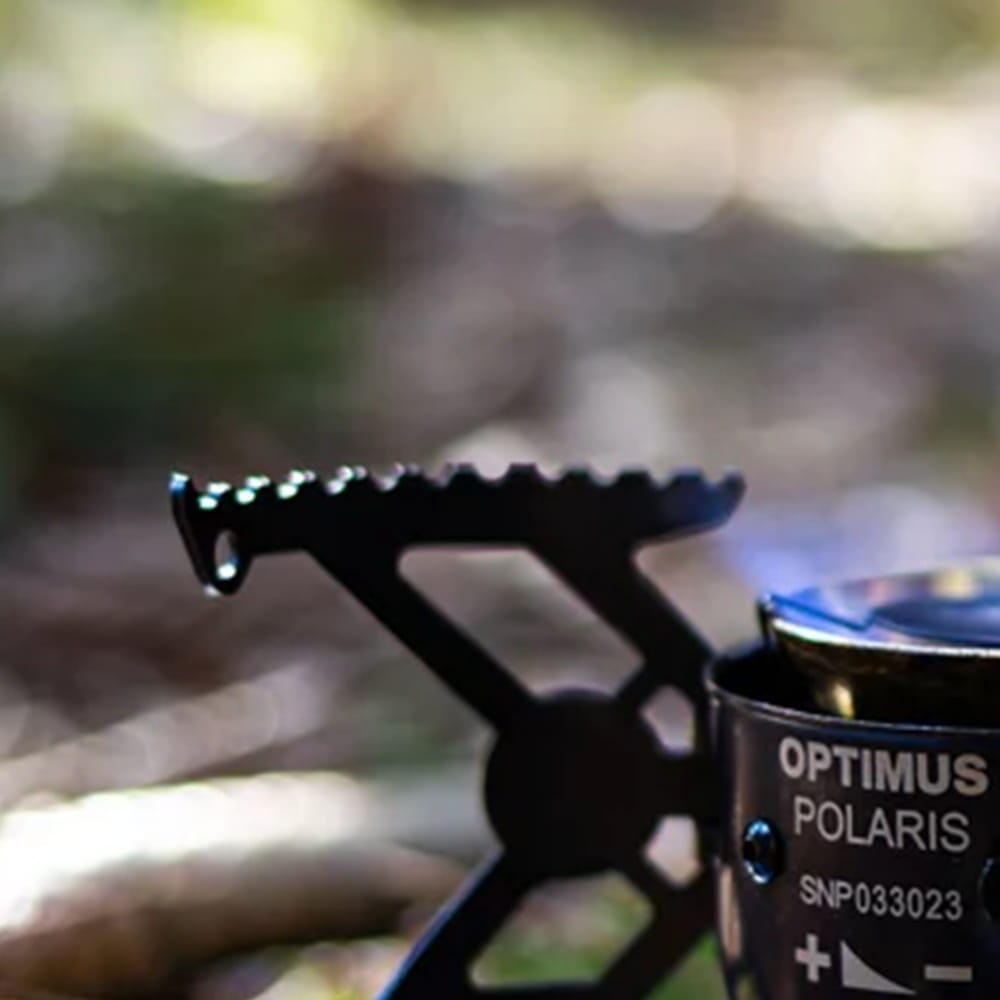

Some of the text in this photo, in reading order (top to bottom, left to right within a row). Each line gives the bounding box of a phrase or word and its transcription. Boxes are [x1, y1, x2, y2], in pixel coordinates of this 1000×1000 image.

[779, 737, 989, 796] OPTIMUS
[793, 797, 971, 851] POLARIS
[799, 874, 964, 921] SNP033023
